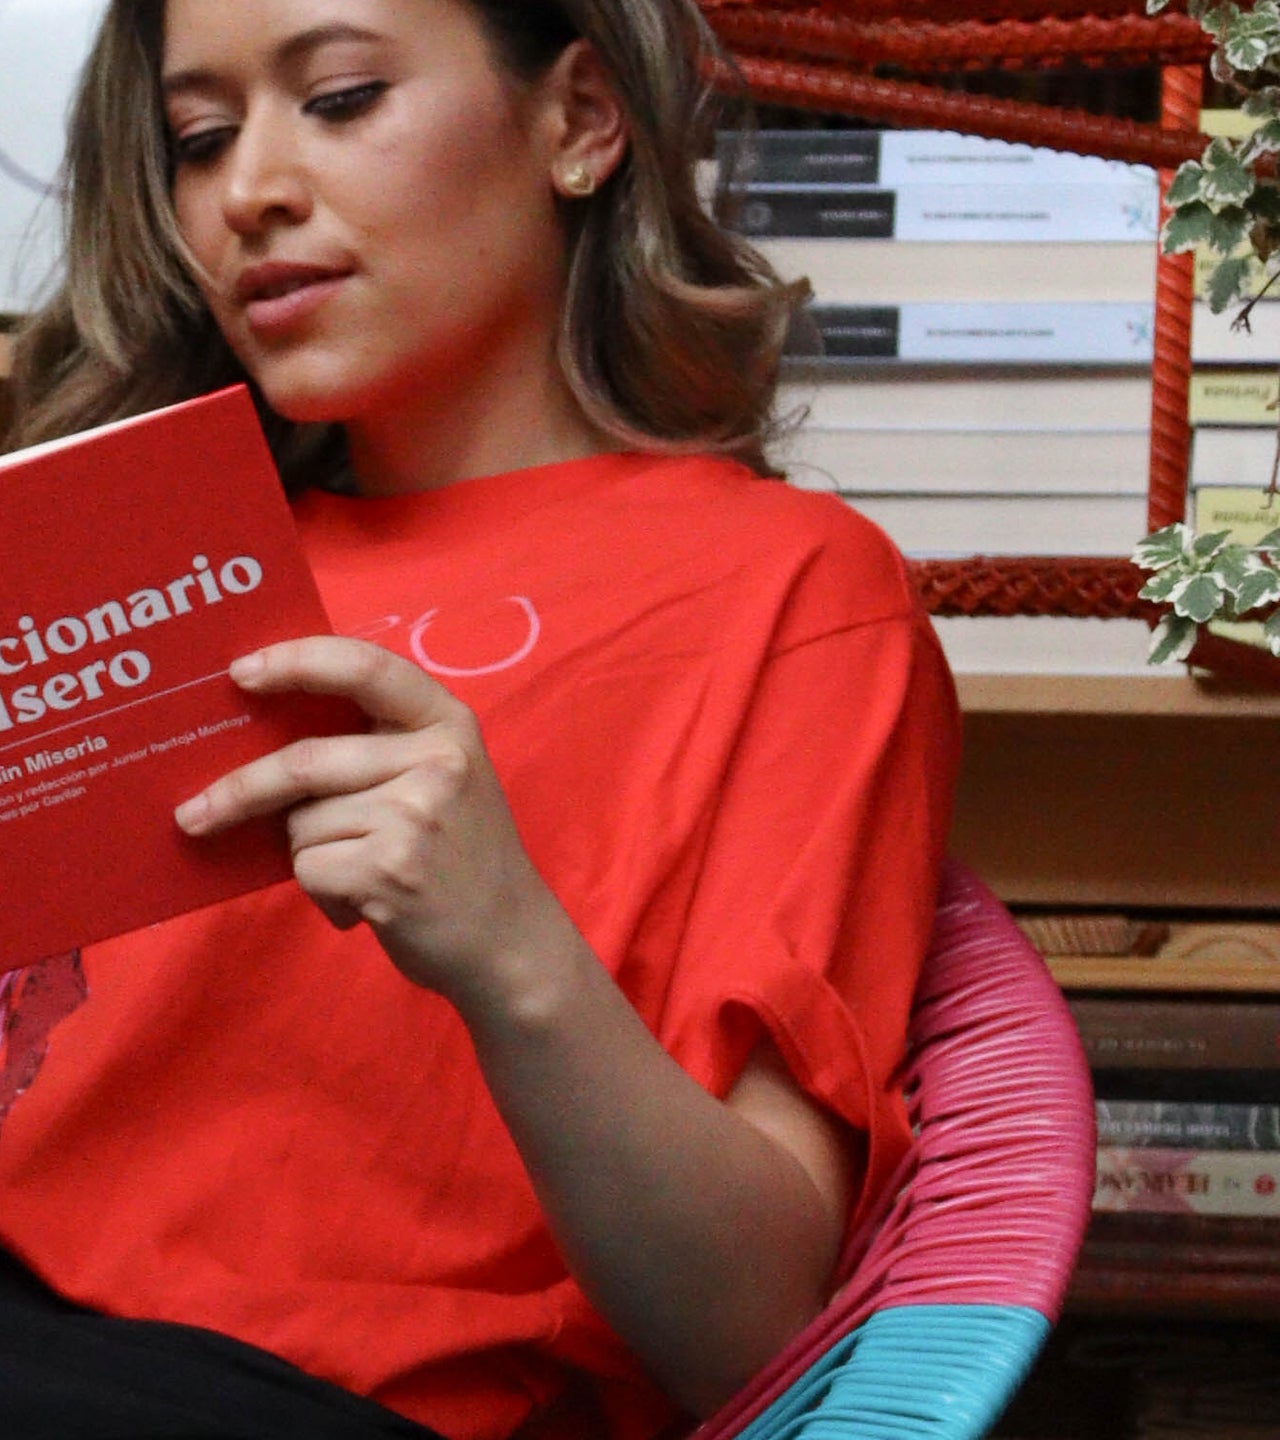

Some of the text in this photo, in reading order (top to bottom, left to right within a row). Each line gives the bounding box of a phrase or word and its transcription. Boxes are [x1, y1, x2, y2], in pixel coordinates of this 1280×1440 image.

[24, 735, 109, 775] Miseria
[88, 762, 109, 782] por
[20, 800, 41, 821] por
